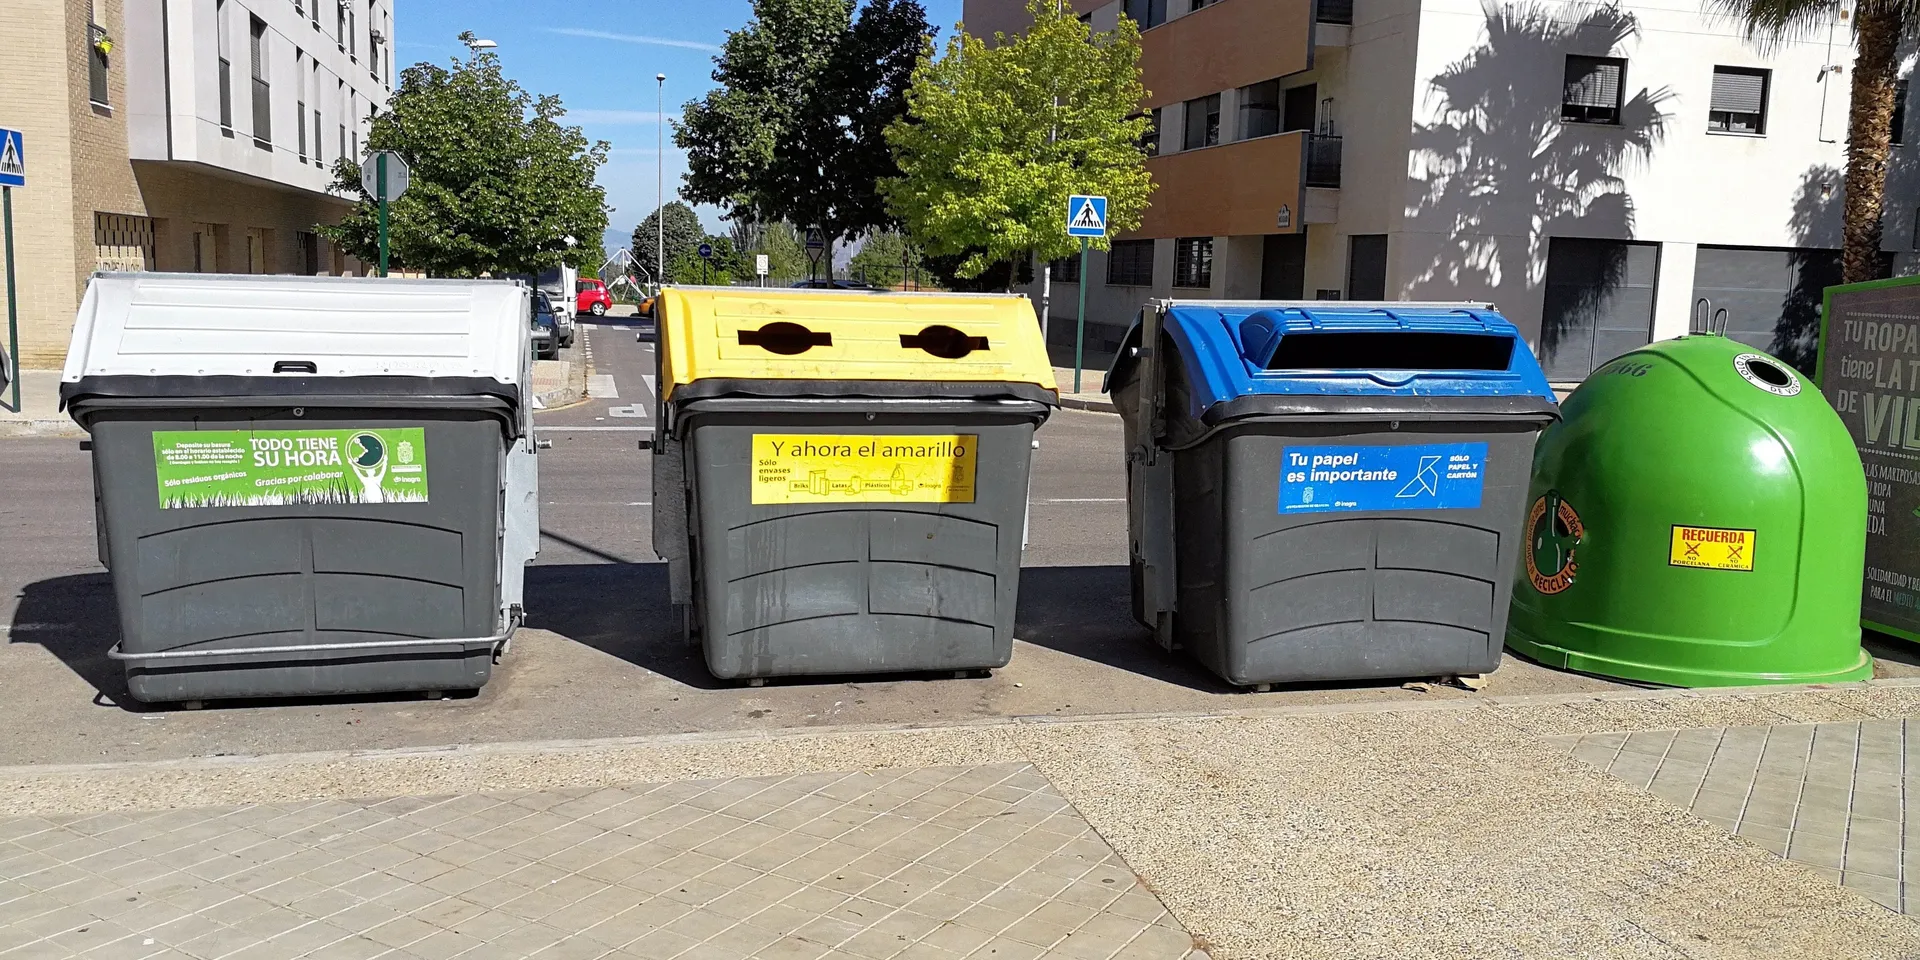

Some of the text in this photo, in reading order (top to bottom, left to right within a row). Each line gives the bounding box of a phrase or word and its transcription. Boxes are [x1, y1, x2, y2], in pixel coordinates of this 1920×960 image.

[1844, 320, 1918, 354] TU ROPA
[1840, 354, 1875, 380] tiene
[1875, 357, 1901, 390] LA
[1836, 389, 1858, 413] DE
[249, 437, 339, 450] TODO TIENE
[771, 440, 965, 457] Y ahora el amarillo
[253, 450, 280, 466] SU
[284, 450, 342, 466] HORA
[1289, 452, 1358, 468] Tu papel
[1449, 454, 1470, 462] SÓLO
[164, 478, 181, 487] Sólo
[213, 471, 247, 481] orgánicos
[255, 470, 344, 487] Gracias por colaborar
[759, 474, 787, 483] ligeros
[1287, 468, 1398, 484] es importante
[1446, 470, 1477, 479] CARTÓN
[1873, 481, 1891, 498] ROPA
[1867, 515, 1888, 537] IDA.
[1682, 528, 1745, 544] RECUERDA
[1672, 559, 1710, 567] PORCELANA
[1866, 566, 1907, 588] SOLIDARIDAD
[1907, 576, 1912, 589] Y
[1870, 585, 1886, 601] PARA
[1886, 589, 1892, 603] EL
